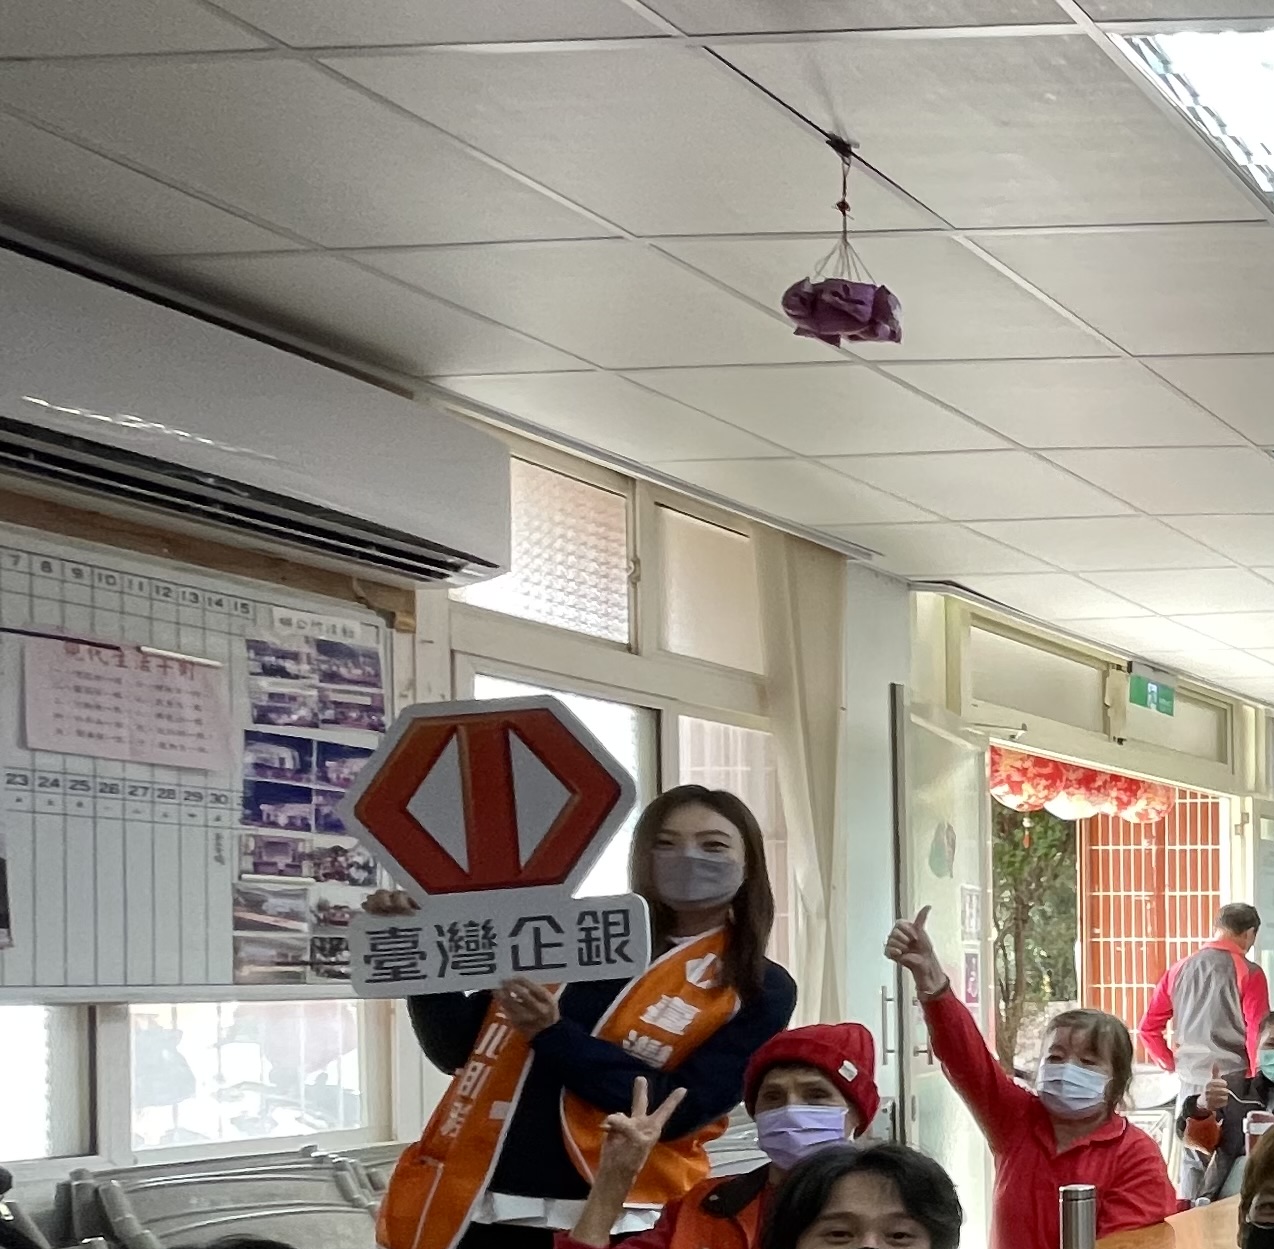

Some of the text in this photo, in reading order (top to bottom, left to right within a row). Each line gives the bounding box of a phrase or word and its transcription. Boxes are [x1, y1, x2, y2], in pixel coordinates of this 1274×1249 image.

[8, 554, 250, 614] 7 8 9 10 11 12 13 14 15
[6, 773, 228, 804] 23 24 25 26 27 28 29 30
[363, 908, 634, 984] 臺灣企銀
